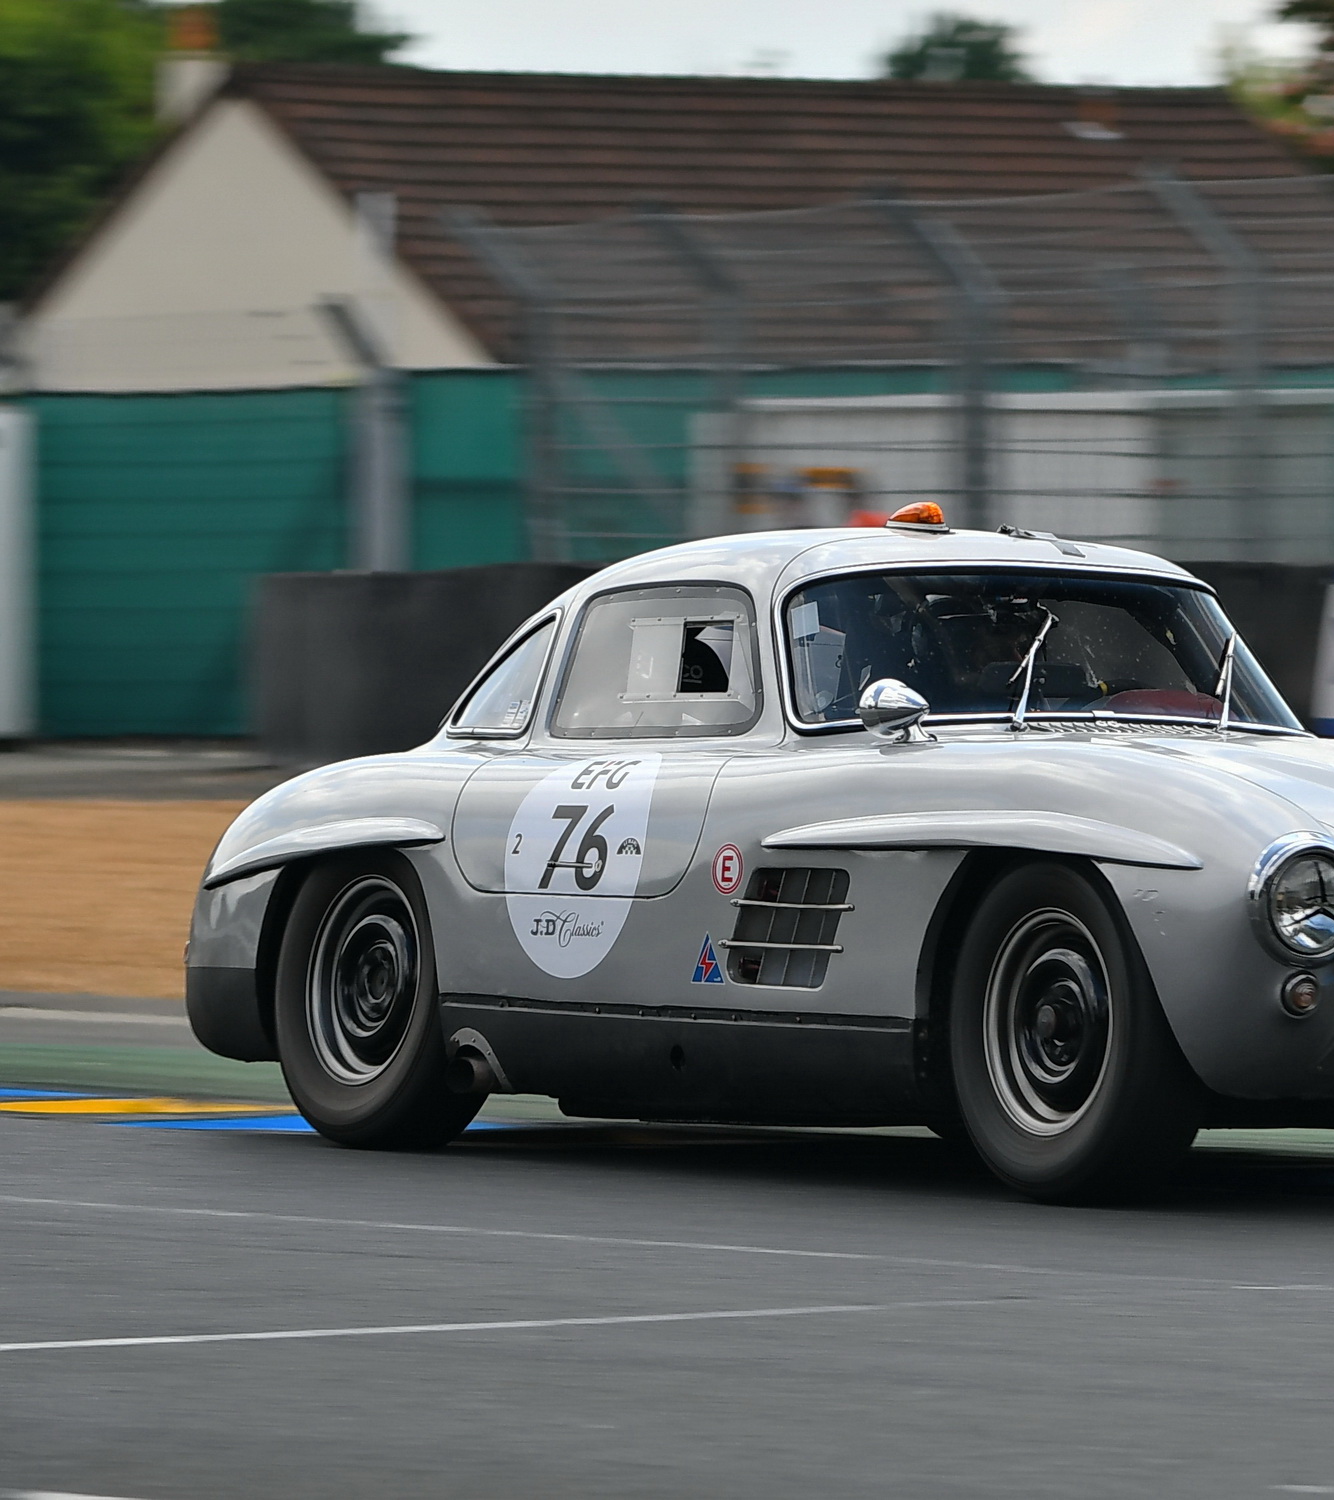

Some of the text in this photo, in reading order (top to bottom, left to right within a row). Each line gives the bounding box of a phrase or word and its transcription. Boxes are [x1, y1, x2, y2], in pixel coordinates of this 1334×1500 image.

[571, 760, 642, 790] EFG
[512, 833, 523, 855] 2
[537, 804, 615, 891] 76
[721, 855, 734, 883] E
